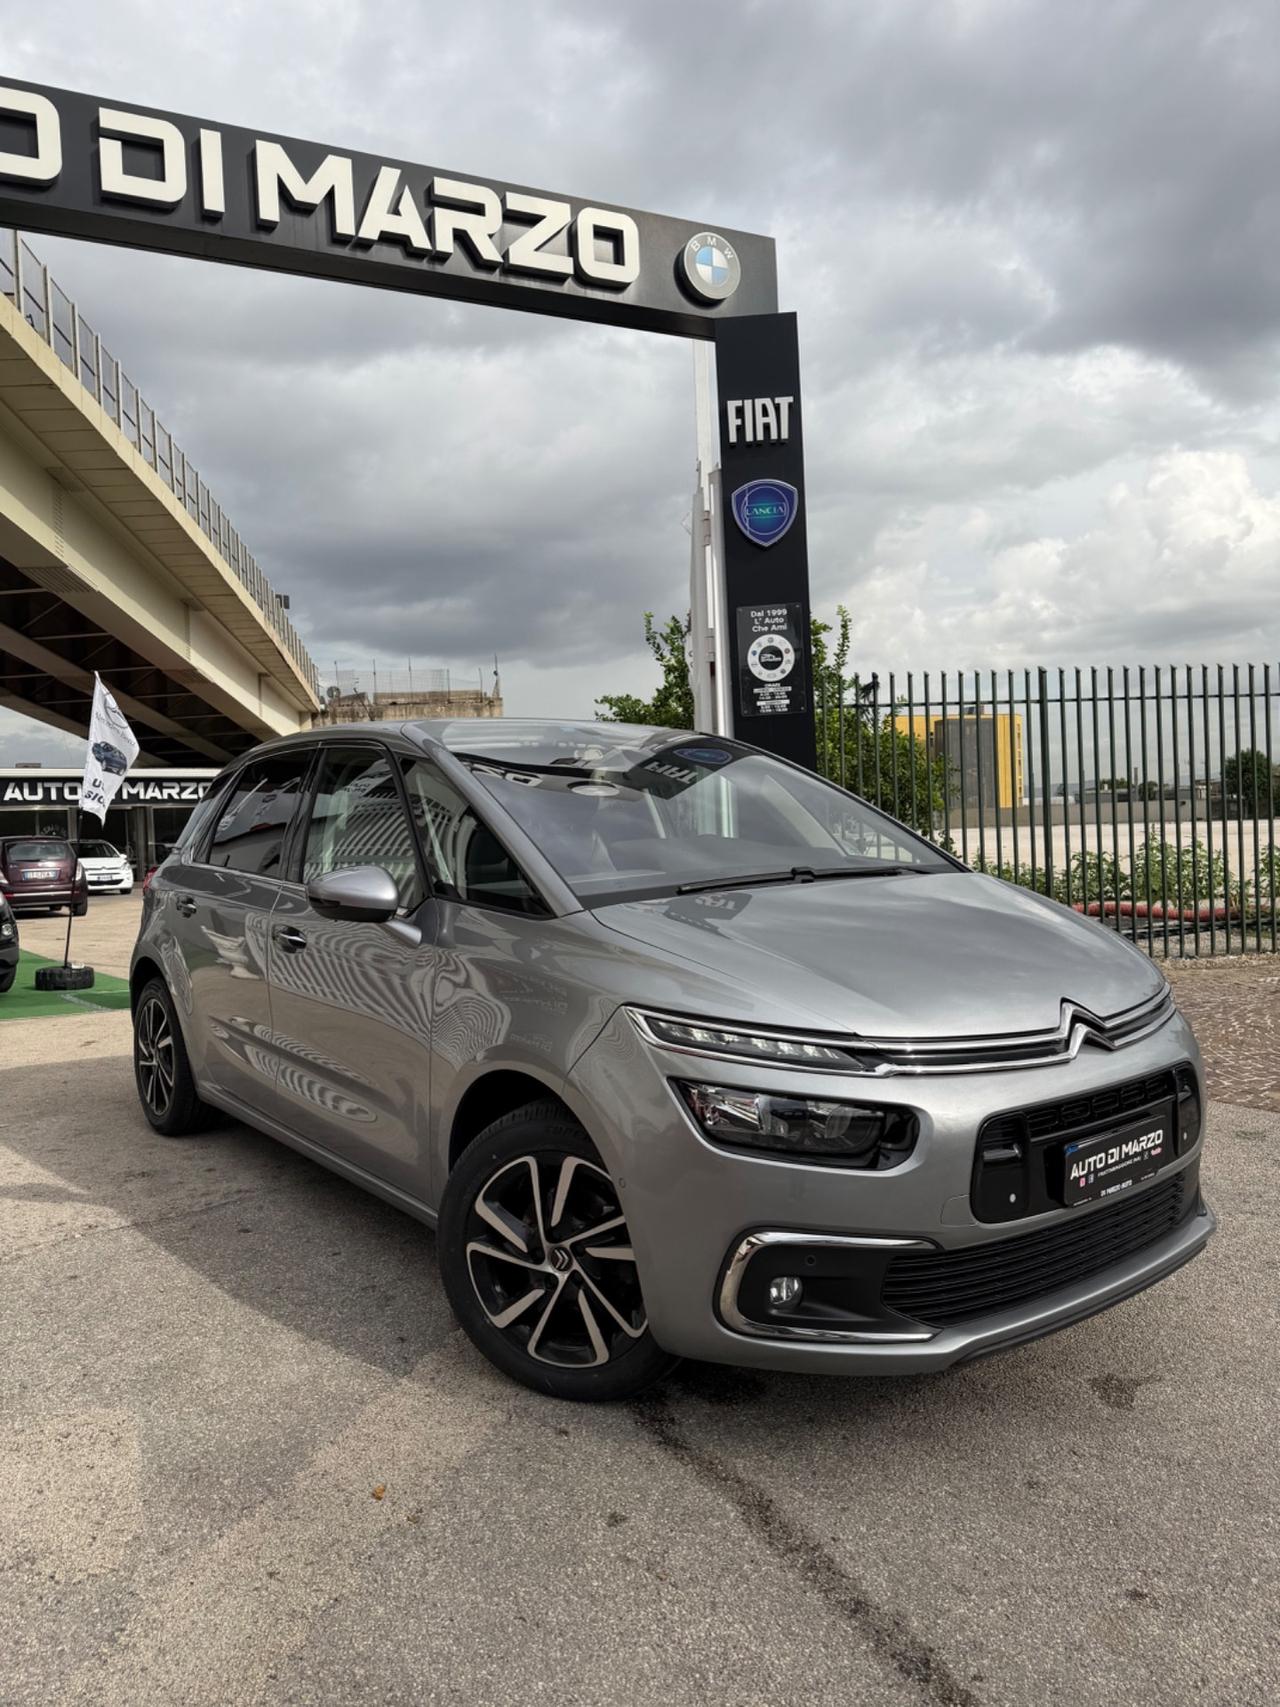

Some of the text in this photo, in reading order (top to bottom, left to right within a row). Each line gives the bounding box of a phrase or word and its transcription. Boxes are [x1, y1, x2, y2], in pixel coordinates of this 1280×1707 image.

[98, 106, 225, 212] DI
[255, 139, 640, 286] MARZO
[690, 235, 734, 259] BMW
[727, 396, 794, 443] FIAT
[746, 503, 785, 516] LANCIA
[750, 608, 787, 618] Dal 1999
[770, 623, 787, 631] Ami
[3, 782, 82, 801] AUTO
[1070, 1152, 1106, 1180] AUTO
[1107, 1146, 1120, 1164] DI
[1121, 1129, 1163, 1159] MARZO
